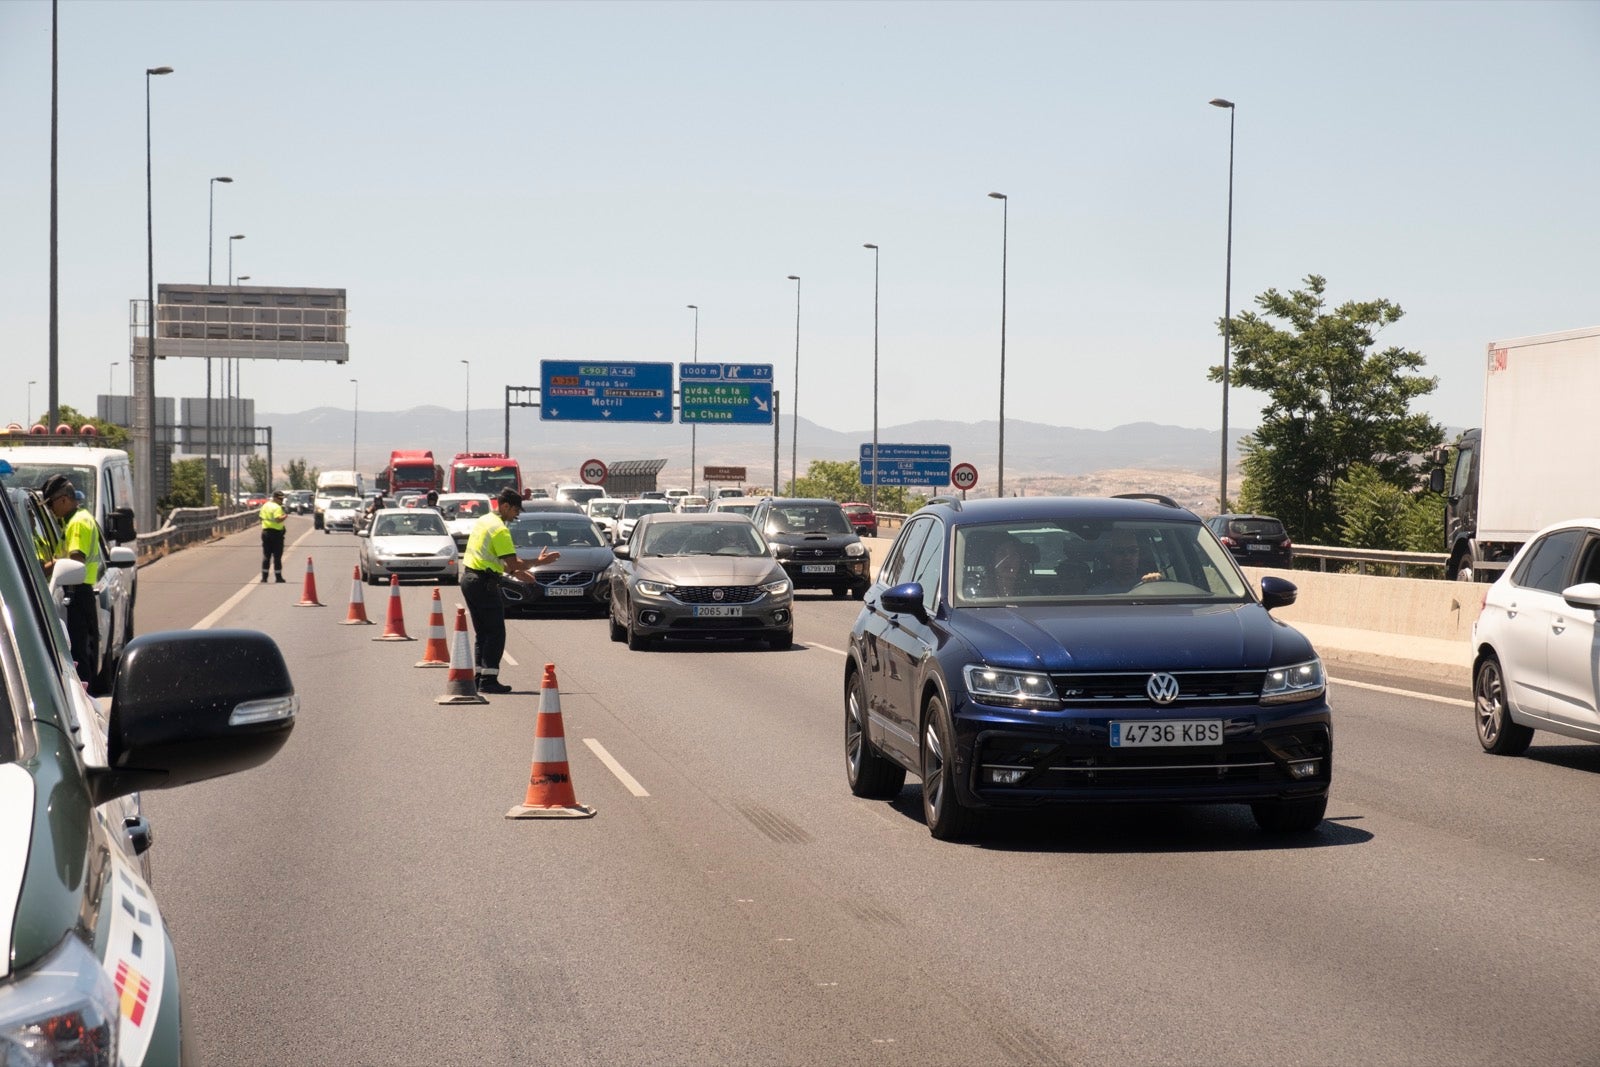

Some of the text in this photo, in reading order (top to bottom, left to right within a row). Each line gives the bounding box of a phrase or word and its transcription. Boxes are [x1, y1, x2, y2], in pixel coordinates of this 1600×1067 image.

[611, 367, 634, 376] A-44
[753, 368, 768, 376] 127
[552, 388, 586, 396] Alhambra
[714, 387, 726, 395] de
[591, 398, 622, 407] Motril
[700, 410, 733, 418] Chana
[586, 468, 602, 477] 100
[956, 471, 974, 482] 100
[699, 607, 721, 616] 2065
[1125, 724, 1219, 743] 4736 KBS
